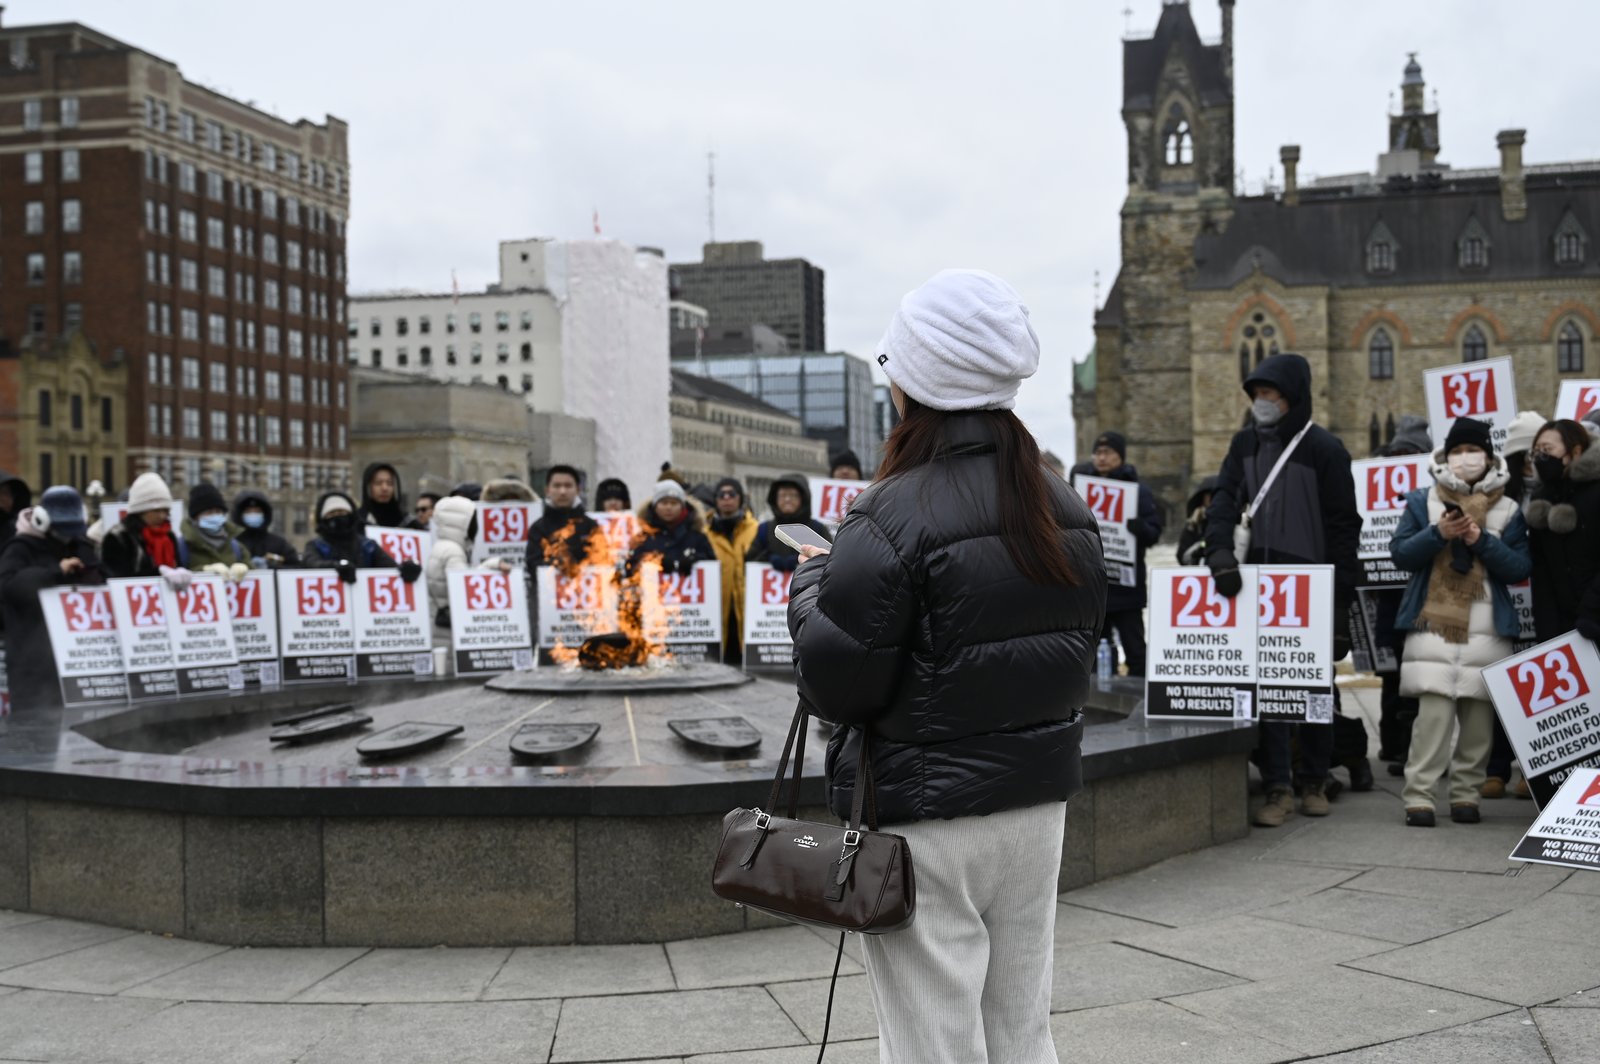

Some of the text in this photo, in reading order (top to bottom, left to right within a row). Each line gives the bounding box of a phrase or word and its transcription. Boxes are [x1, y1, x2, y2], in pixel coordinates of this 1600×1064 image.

[1447, 370, 1490, 418] 37
[1373, 465, 1411, 510] 19
[1090, 485, 1121, 522] 27
[488, 508, 524, 543] 39
[386, 534, 420, 565] 39
[1363, 561, 1376, 571] NO
[302, 577, 341, 615] 55
[374, 577, 412, 613] 51
[469, 575, 509, 610] 36
[1176, 576, 1231, 627] 25
[65, 592, 113, 631] 34
[179, 583, 215, 624] 23
[302, 619, 341, 628] MONTHS
[374, 617, 411, 626] MONTHS
[472, 614, 509, 623] MONTHS
[293, 630, 351, 640] WAITING FOR
[1176, 633, 1229, 646] MONTHS
[1163, 649, 1243, 661] WAITING FOR
[1290, 651, 1316, 664] FOR
[1155, 664, 1250, 677] IRCC RESPONSE
[1166, 686, 1181, 698] NO
[1517, 650, 1580, 716] 23
[1170, 698, 1232, 711] NO RESULTS
[1536, 702, 1590, 733] MONTHS
[1529, 723, 1583, 752] WAITING
[1528, 750, 1557, 771] IRCC
[1549, 770, 1566, 785] NO
[1539, 825, 1571, 837] IRCC
[1541, 849, 1560, 859] NO
[1542, 840, 1561, 850] NO
